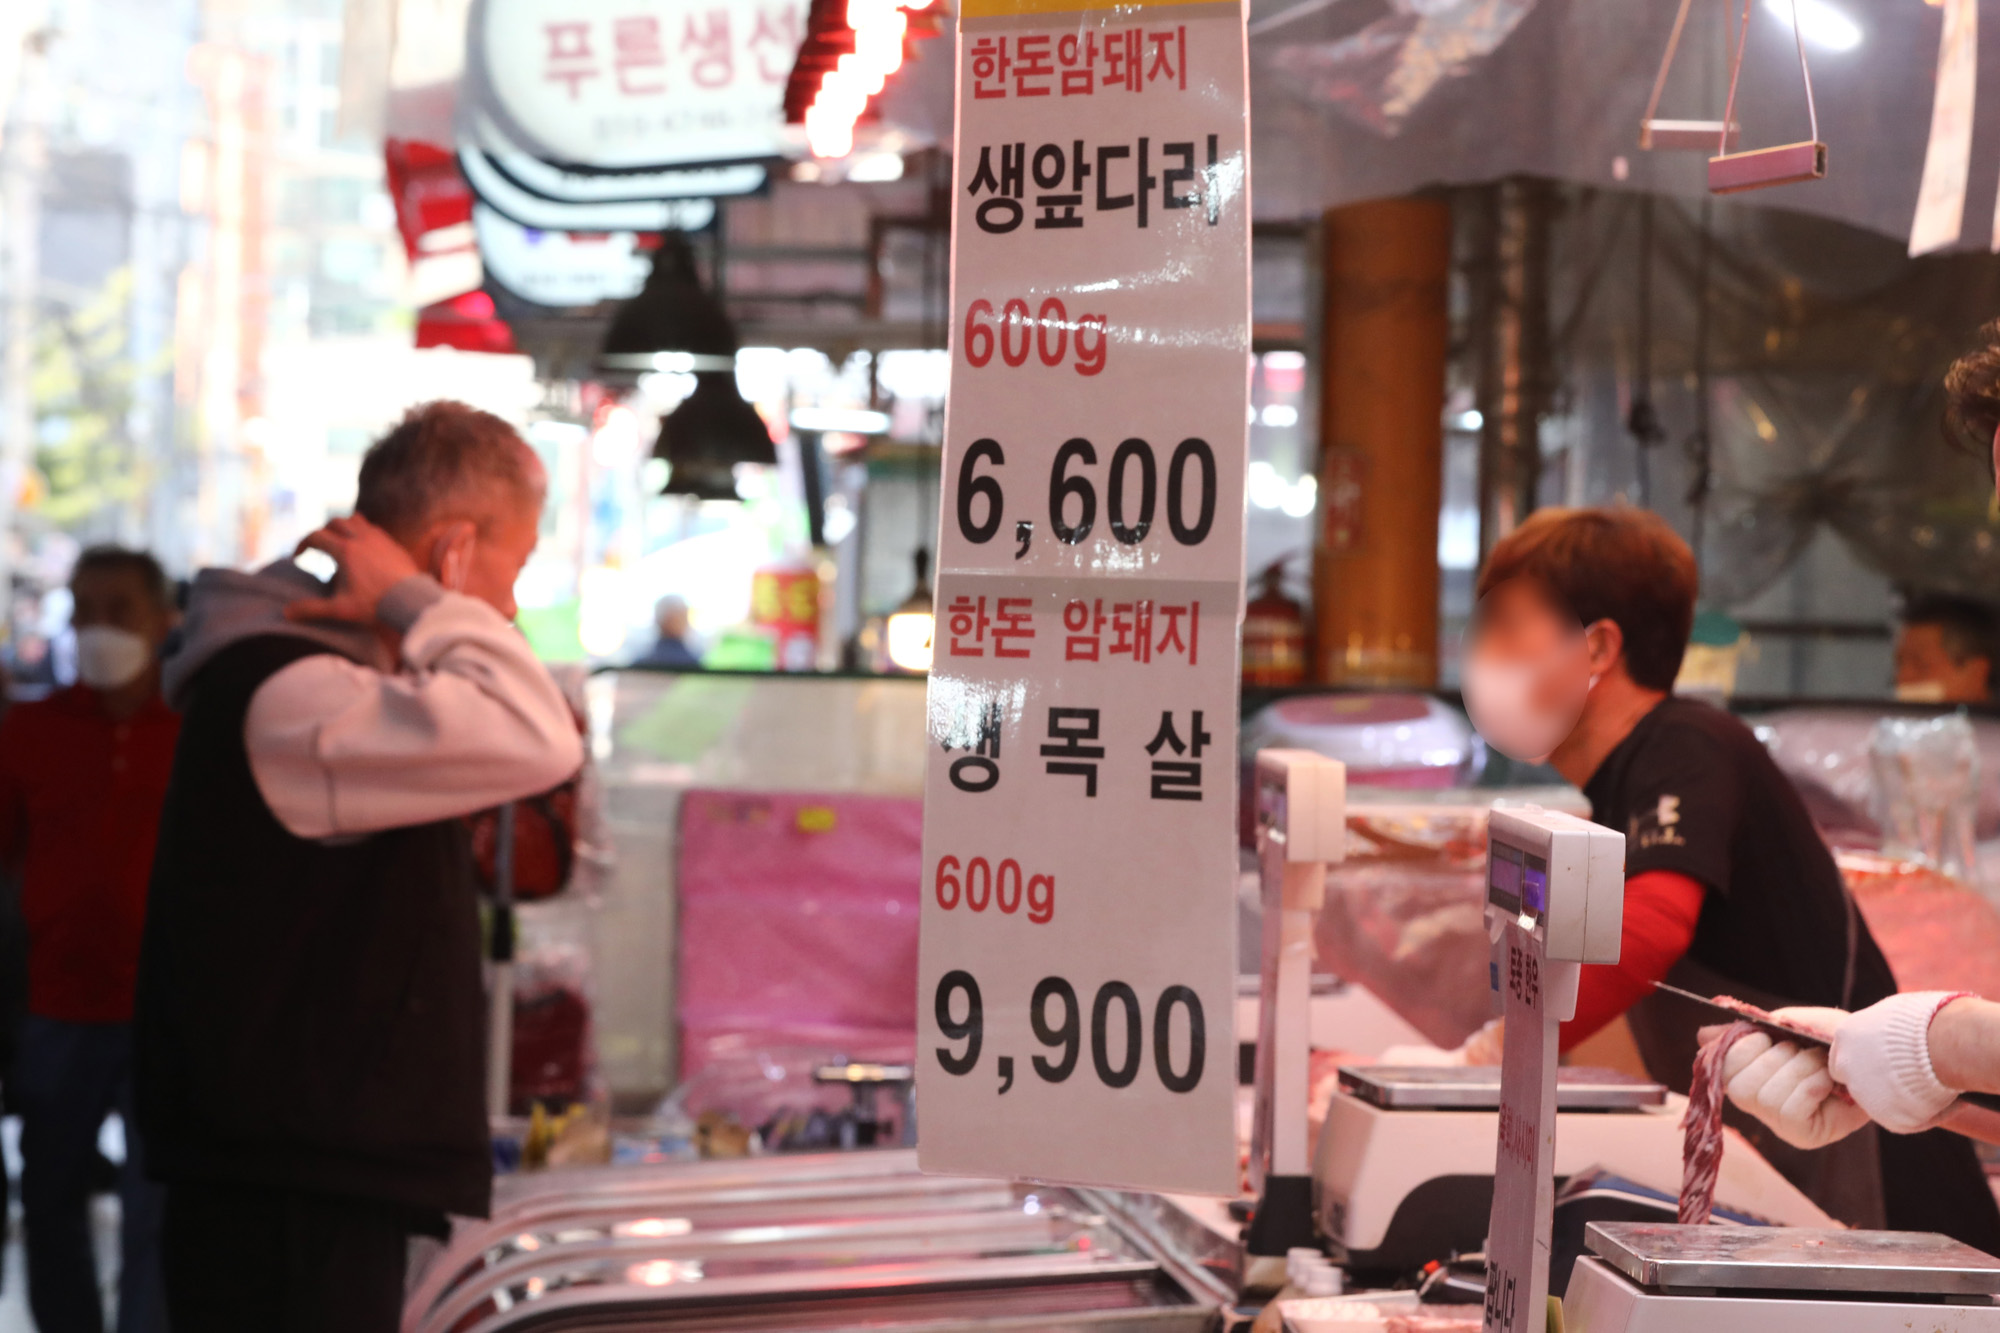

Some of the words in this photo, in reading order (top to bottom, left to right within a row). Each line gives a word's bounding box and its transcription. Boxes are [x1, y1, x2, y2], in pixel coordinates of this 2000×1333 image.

[541, 3, 800, 101] 푸른생선
[970, 25, 1187, 99] 한돈암돼지
[967, 134, 1219, 234] 생앞다리
[963, 297, 1108, 377] 600g
[956, 437, 1217, 560] 6,600
[948, 595, 1036, 660] 한돈
[1062, 598, 1200, 666] 암돼지
[1039, 706, 1106, 798] 목
[1144, 710, 1212, 802] 살
[934, 854, 1056, 924] 600g
[934, 969, 1206, 1096] 9,900
